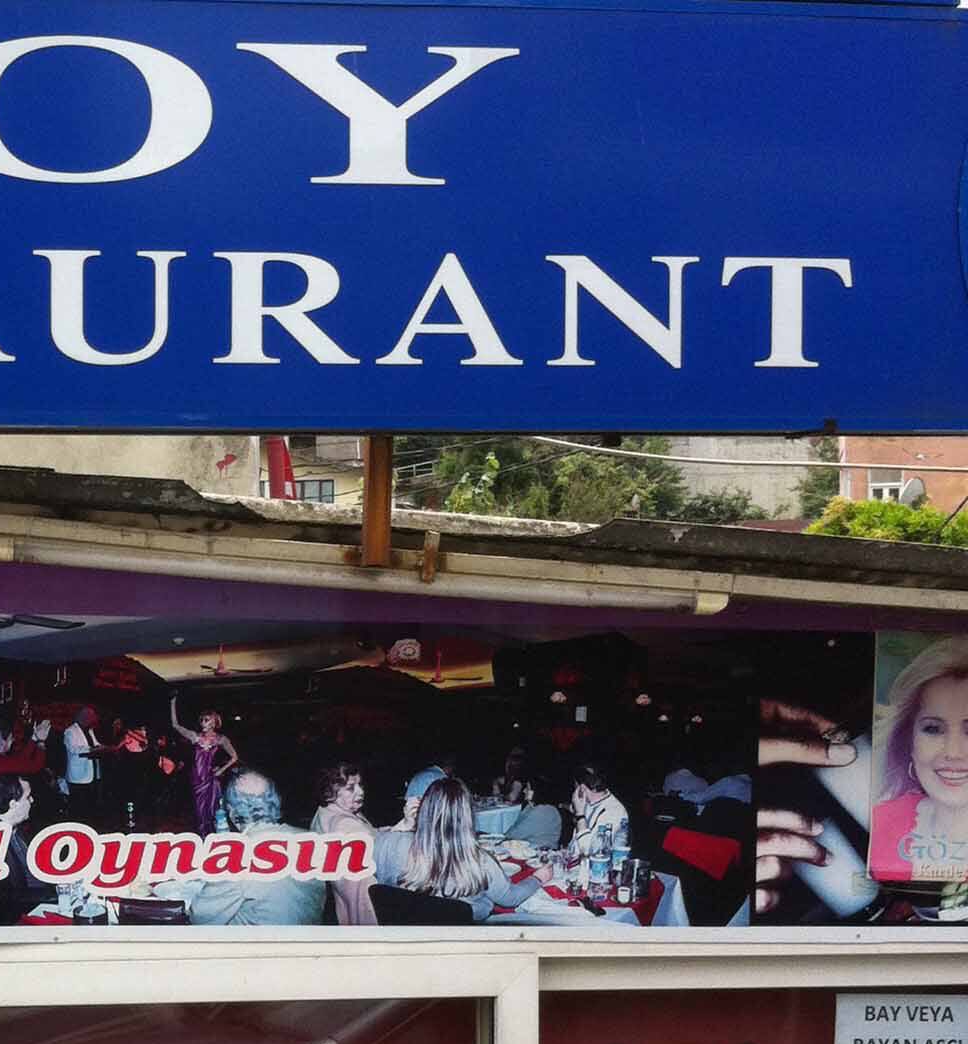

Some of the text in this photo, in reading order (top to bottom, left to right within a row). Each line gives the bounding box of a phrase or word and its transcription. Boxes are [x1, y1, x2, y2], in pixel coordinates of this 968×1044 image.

[34, 829, 370, 888] Oynasın
[864, 1005, 954, 1022] BAY VEYA
